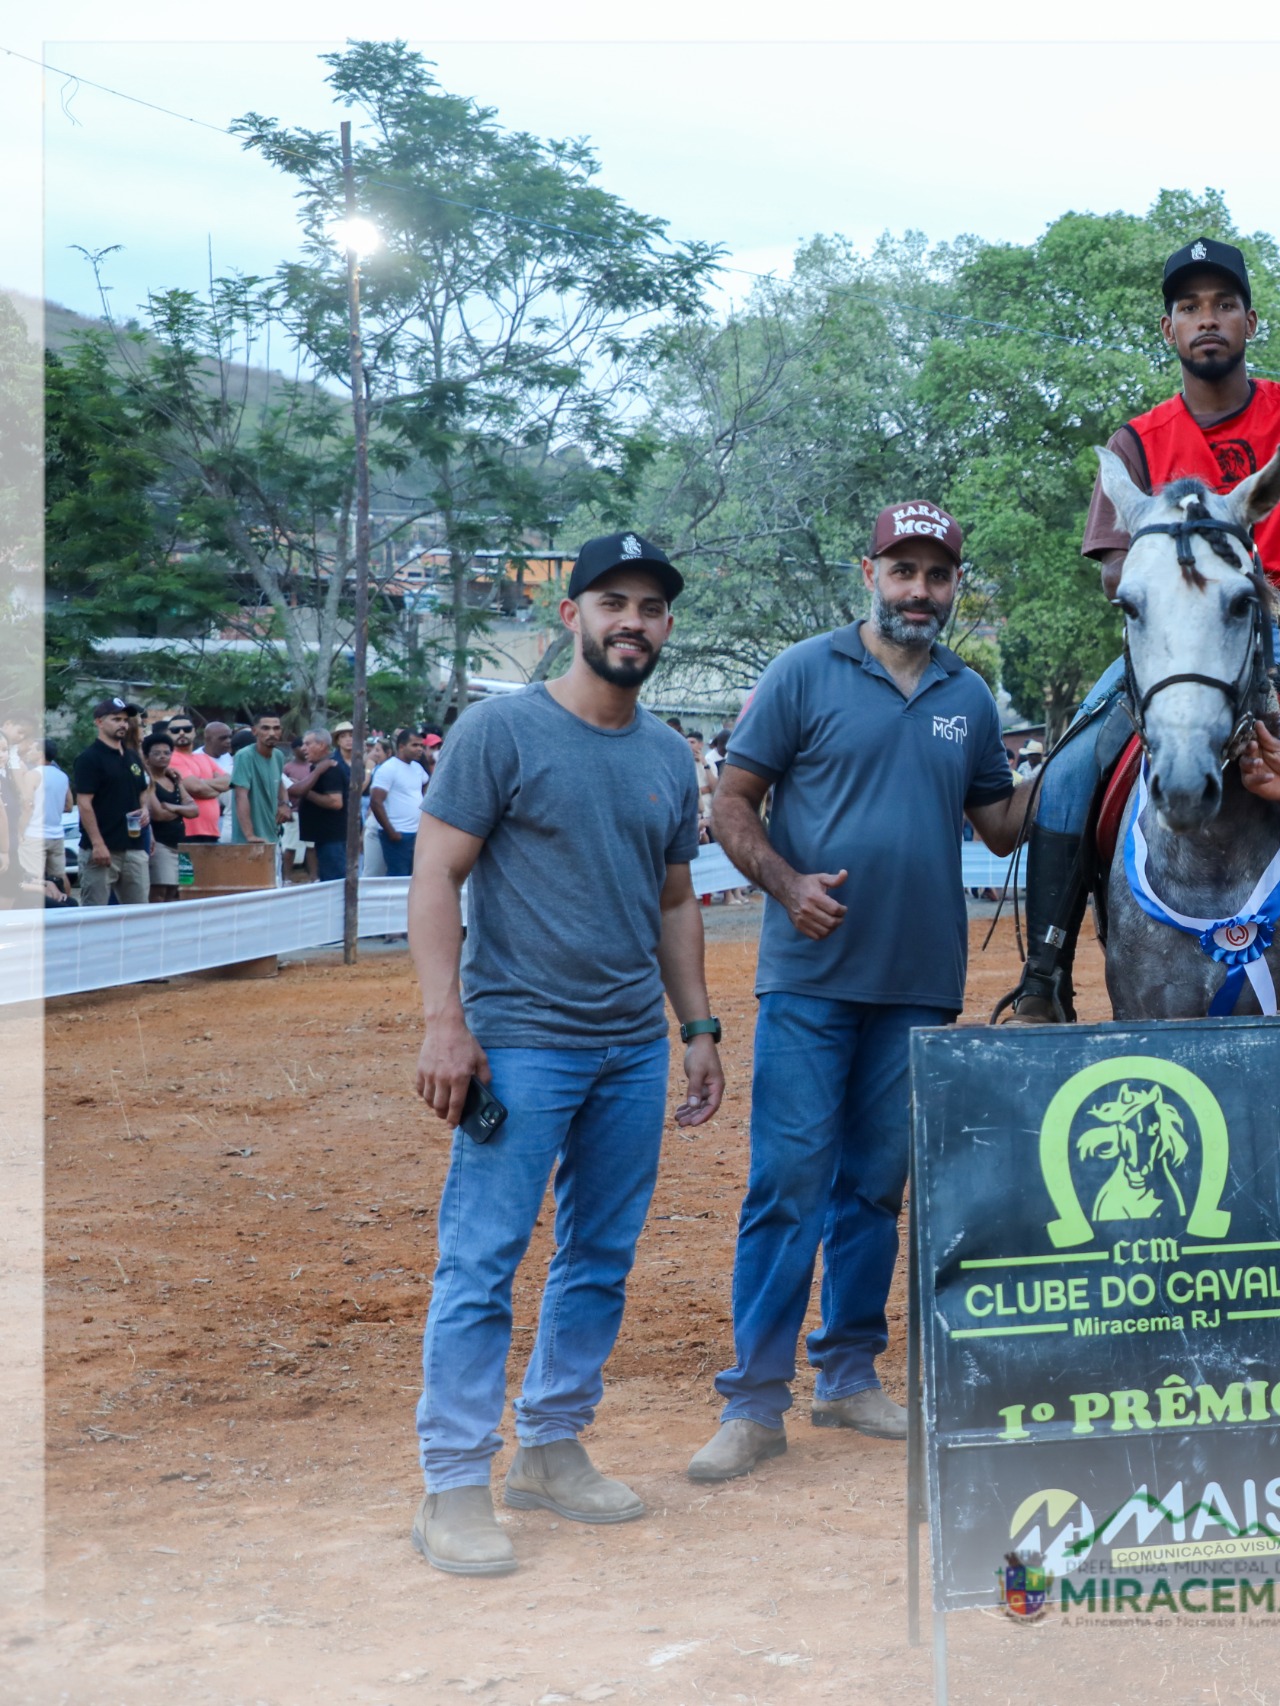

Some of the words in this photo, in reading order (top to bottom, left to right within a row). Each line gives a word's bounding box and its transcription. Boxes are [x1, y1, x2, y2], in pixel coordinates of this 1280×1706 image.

[894, 519, 947, 540] MGT
[965, 1278, 1090, 1318] CLUBE
[1101, 1273, 1156, 1308] DO
[1073, 1313, 1184, 1337] Miracema
[1192, 1309, 1221, 1329] RJ
[1117, 1541, 1236, 1563] COMUNICAÇÃO
